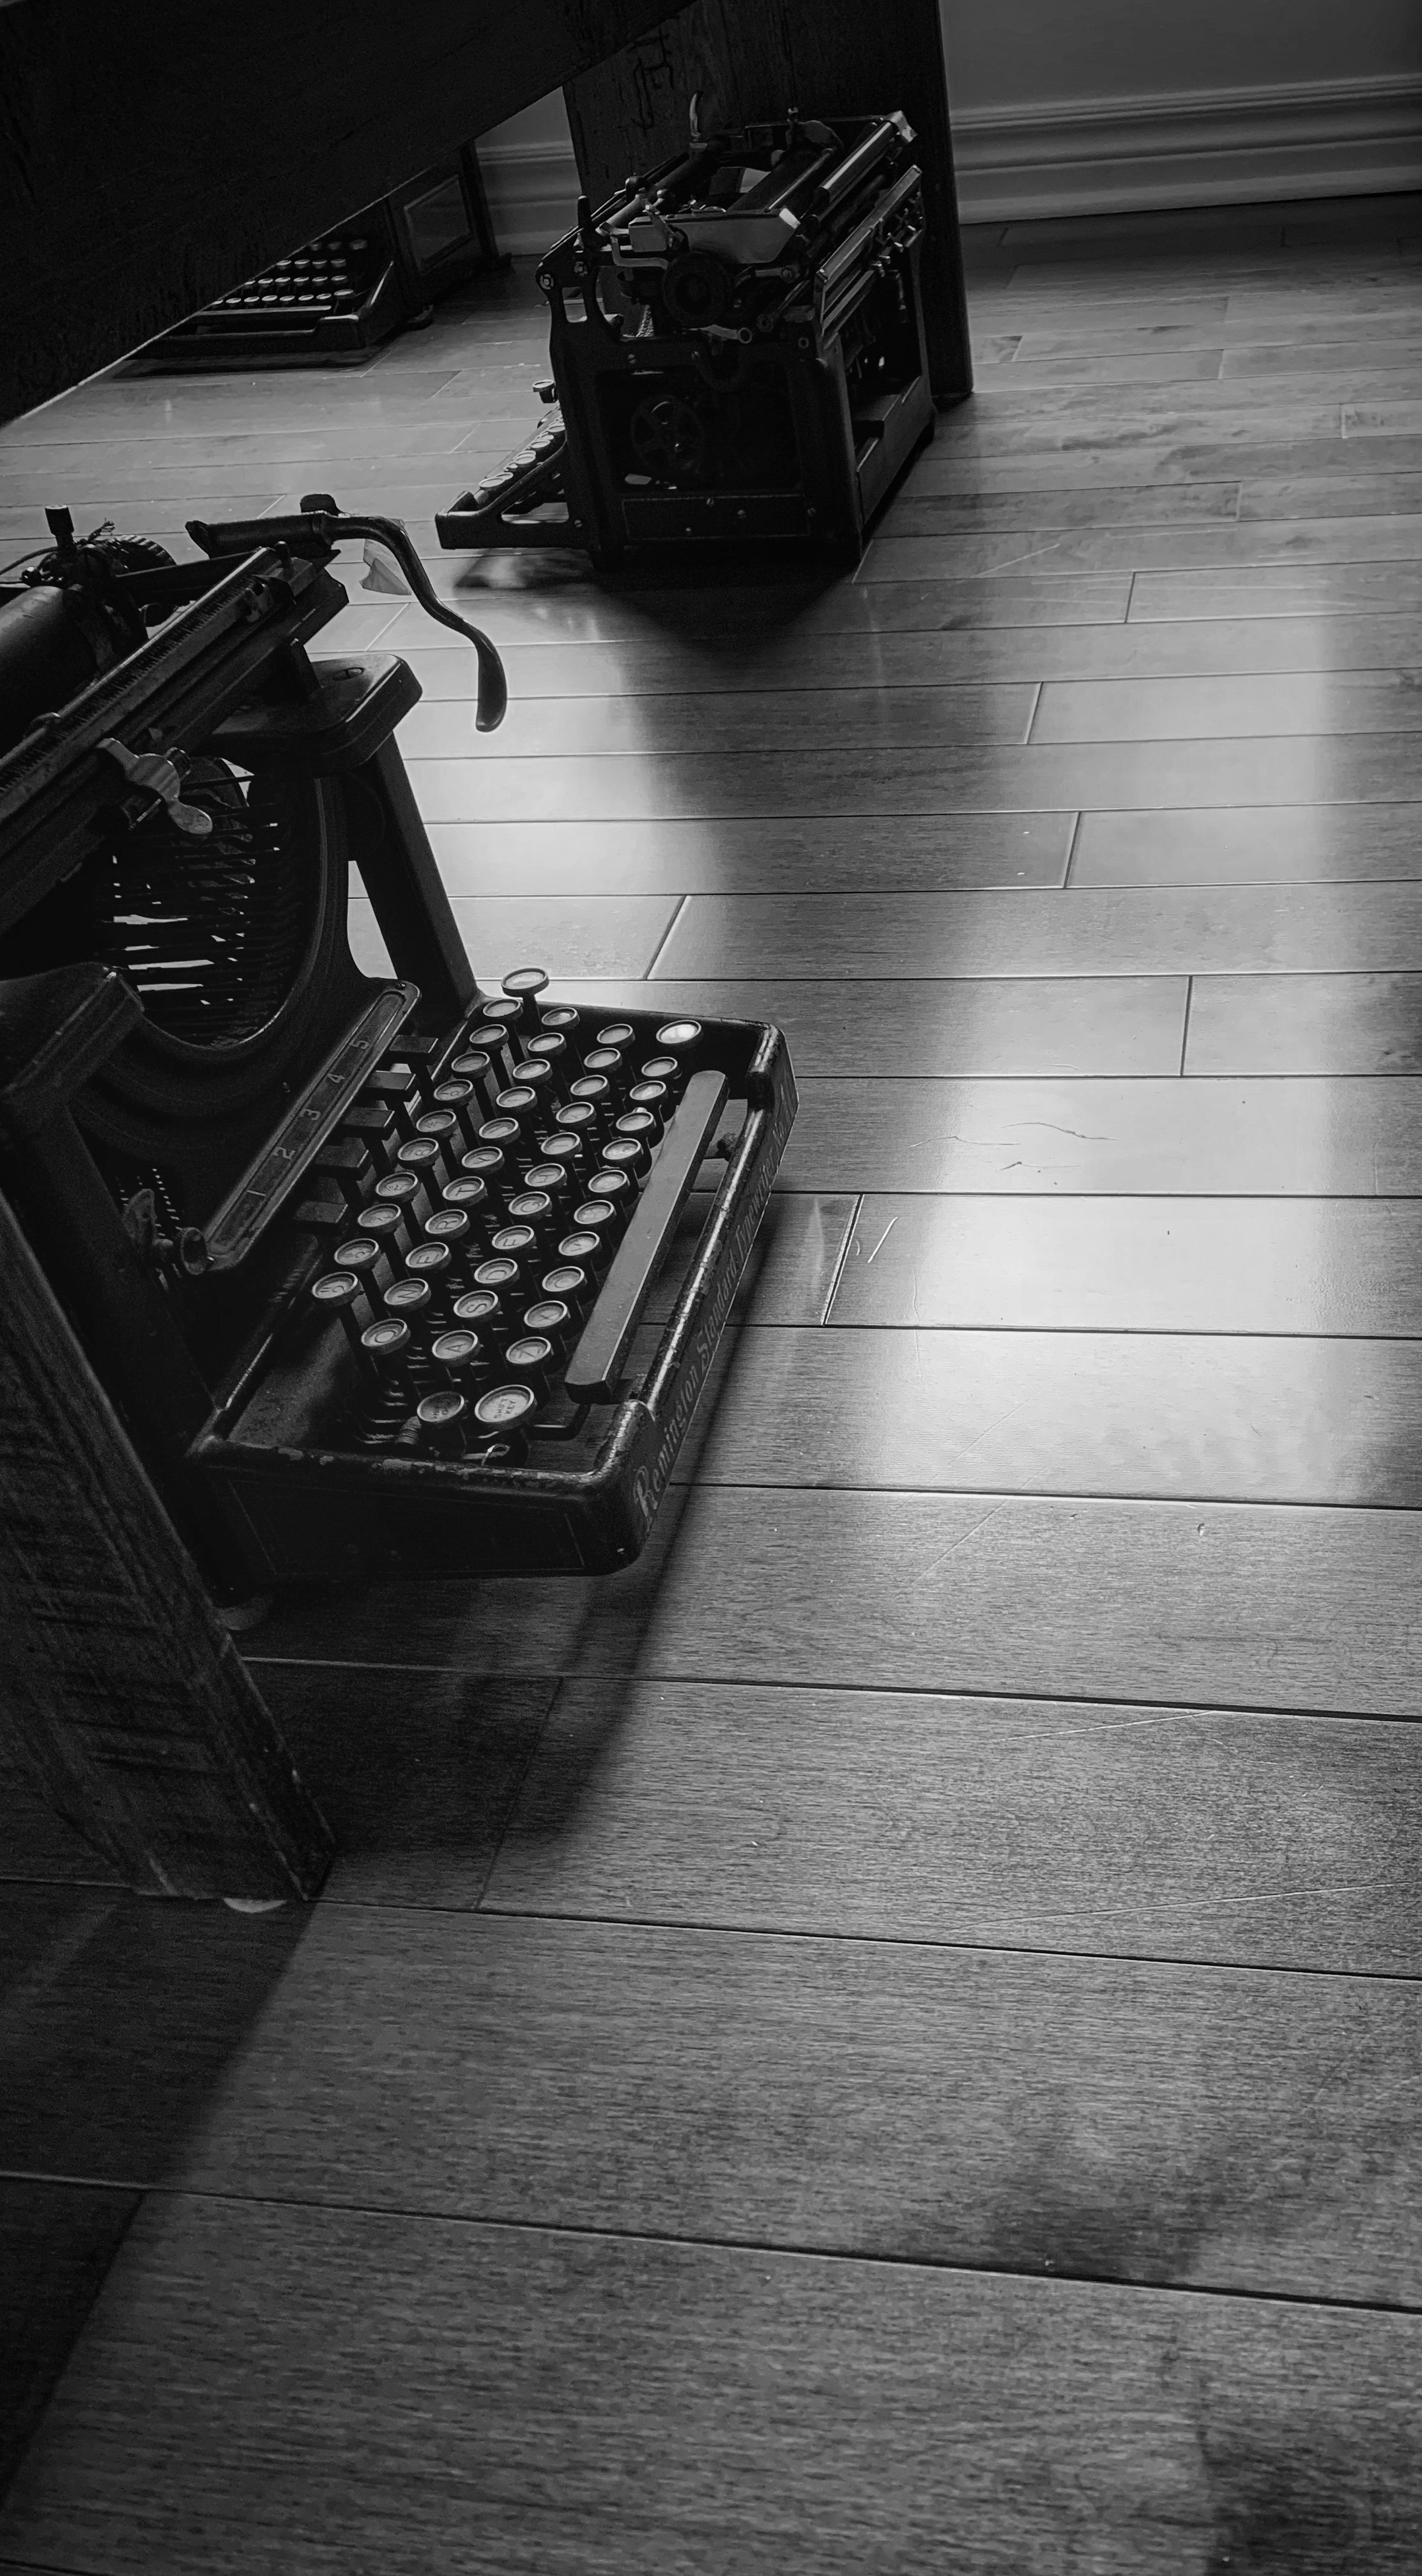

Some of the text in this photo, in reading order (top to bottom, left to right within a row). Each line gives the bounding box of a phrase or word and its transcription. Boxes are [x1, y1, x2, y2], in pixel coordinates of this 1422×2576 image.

[247, 1039, 371, 1197] 1 2 3 4 5
[633, 1365, 699, 1532] Remington
[696, 1249, 737, 1369] Standard
[735, 1147, 774, 1263] Typewriter
